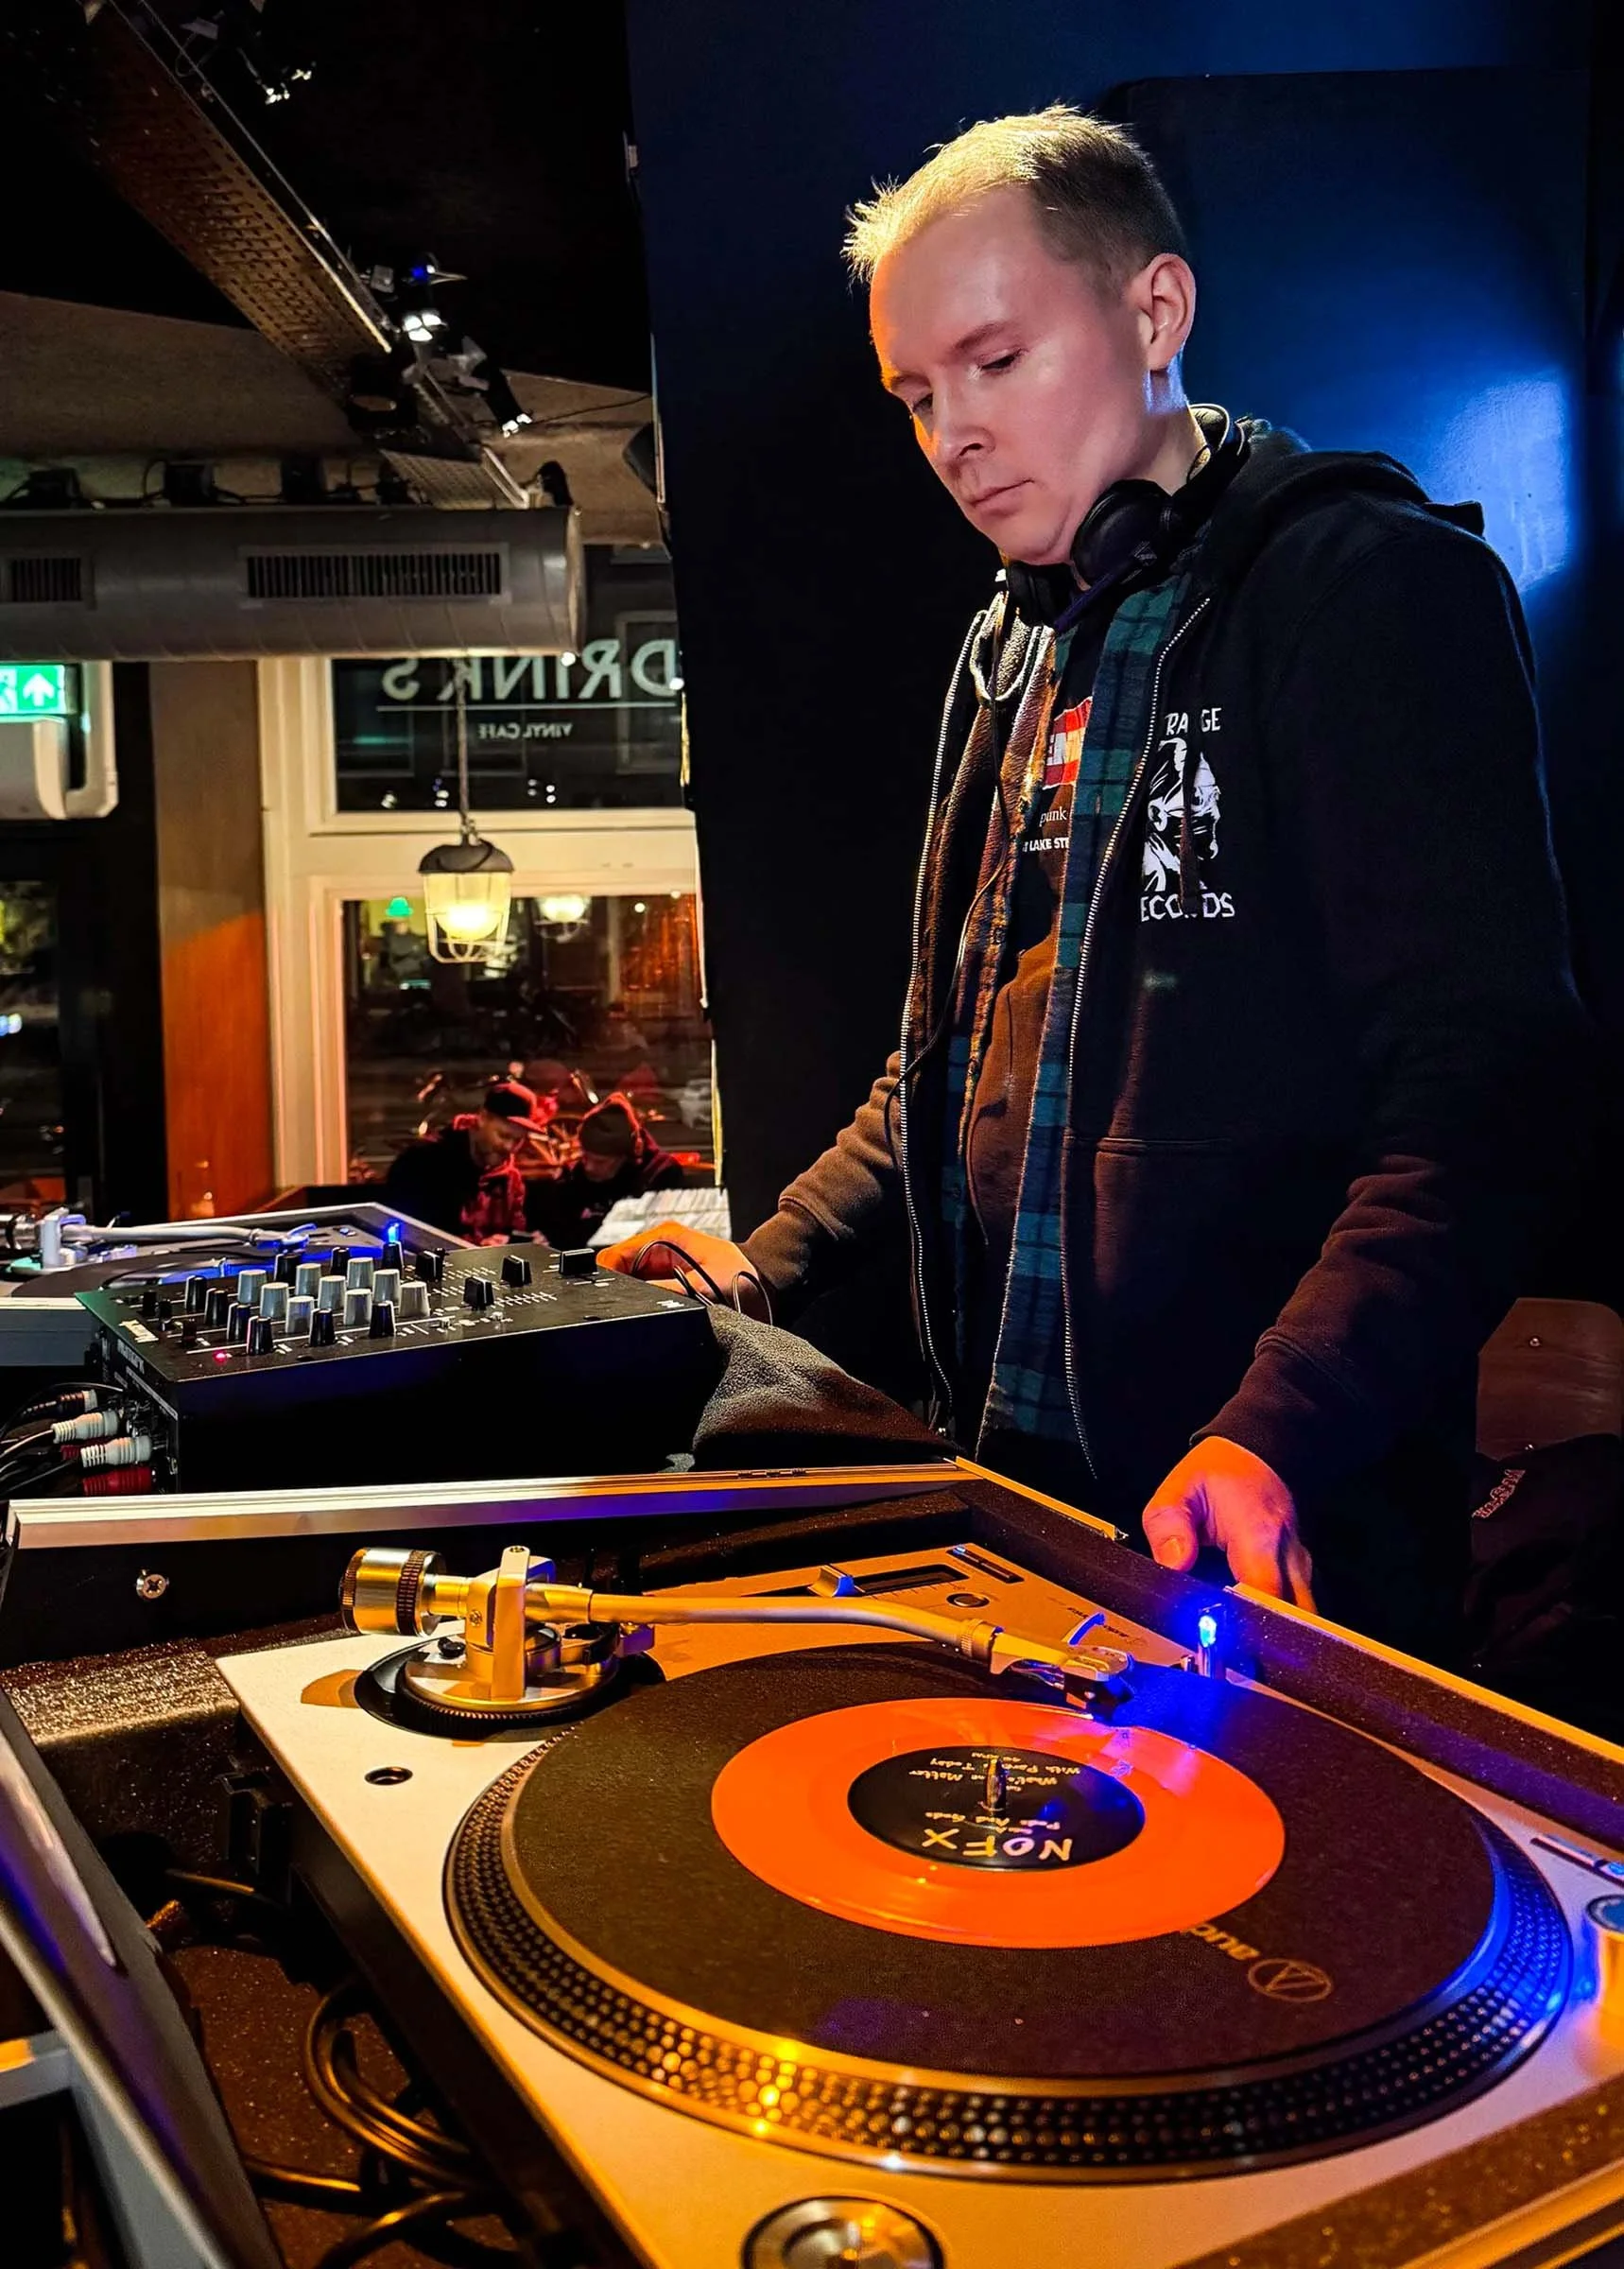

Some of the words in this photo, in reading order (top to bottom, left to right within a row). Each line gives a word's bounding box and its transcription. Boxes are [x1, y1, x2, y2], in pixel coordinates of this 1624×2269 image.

[1164, 707, 1222, 736] RAGE
[1039, 805, 1067, 827] punk
[1029, 838, 1053, 851] LAKE
[1140, 892, 1235, 922] ECODS
[908, 1770, 964, 1781] Matter
[1045, 1765, 1081, 1775] With
[922, 1827, 1073, 1862] NOFX
